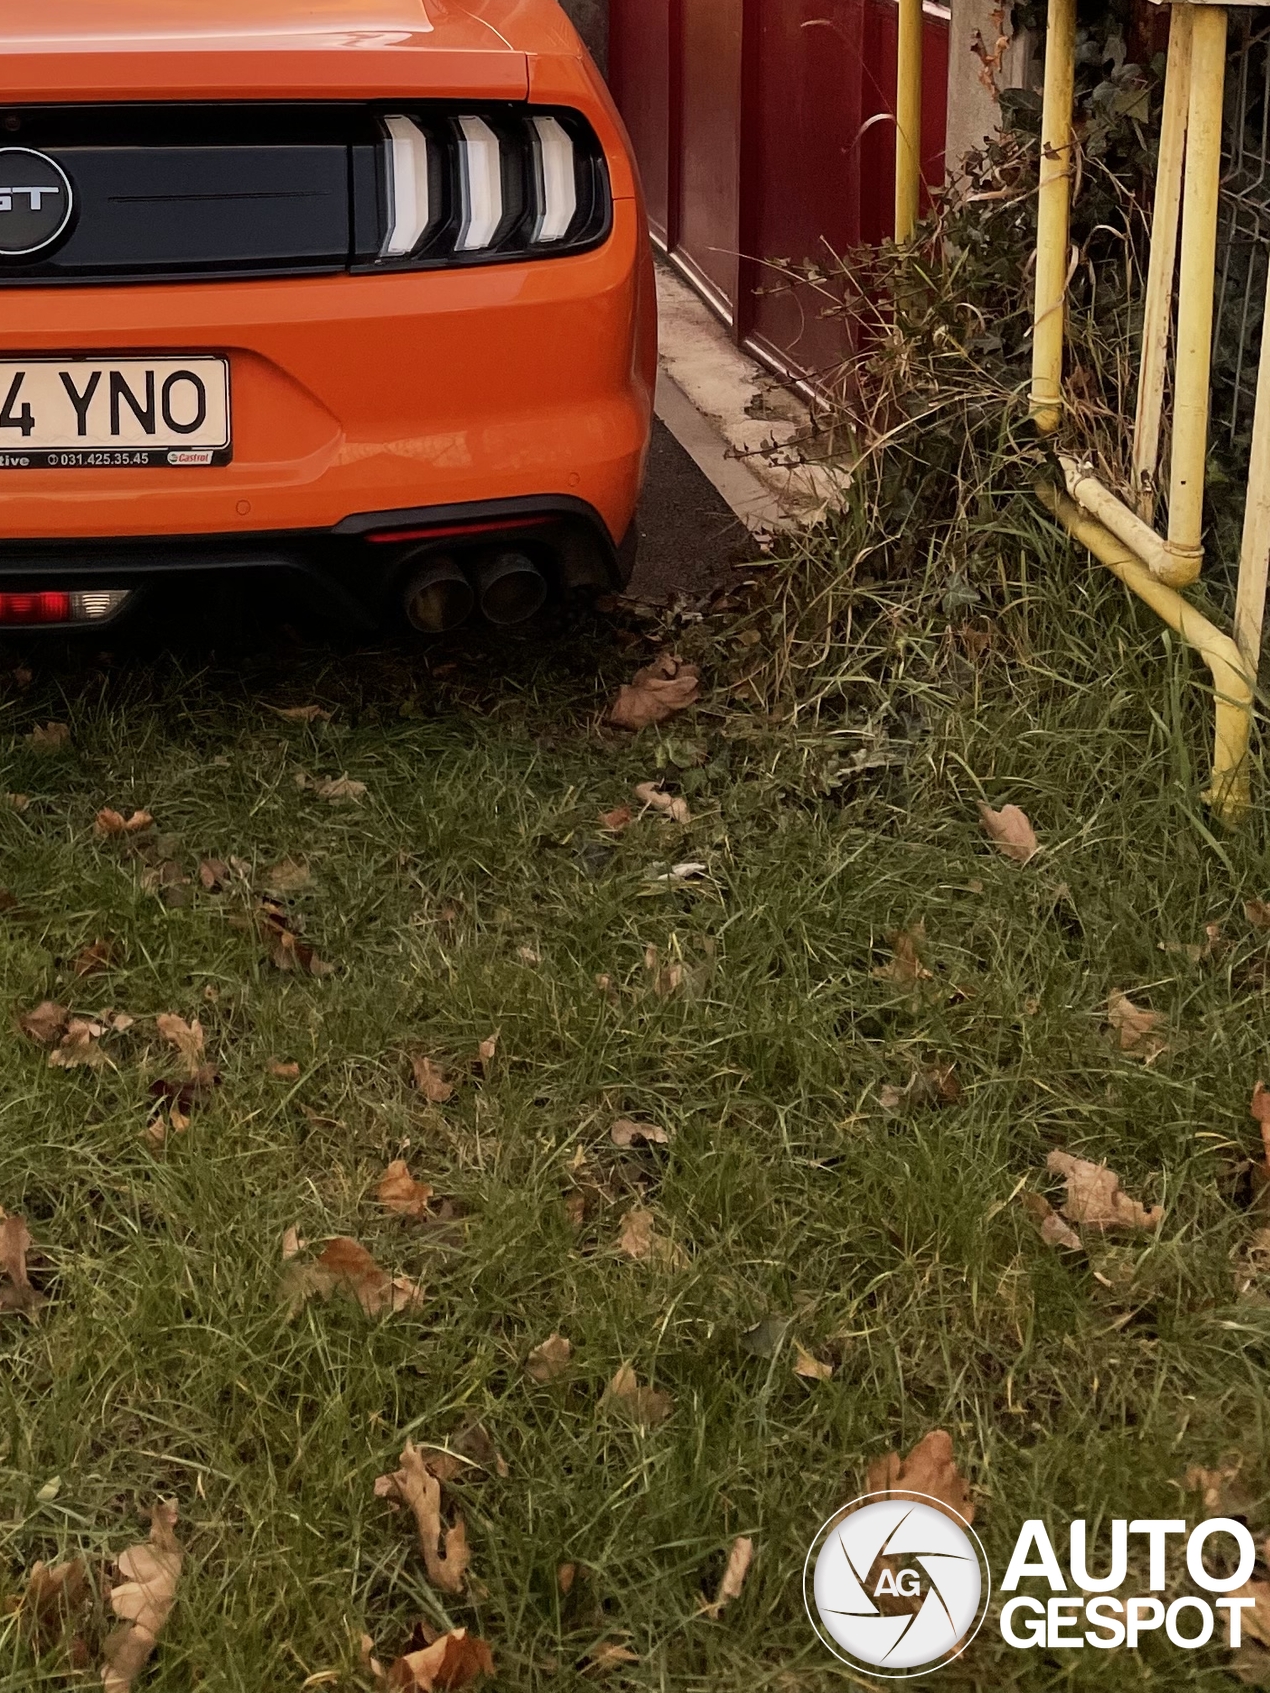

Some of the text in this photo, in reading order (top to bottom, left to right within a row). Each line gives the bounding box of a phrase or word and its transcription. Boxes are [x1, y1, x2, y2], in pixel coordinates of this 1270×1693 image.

[58, 370, 206, 436] YNO
[60, 453, 149, 465] 031.425.35.45
[178, 453, 209, 463] Castrol
